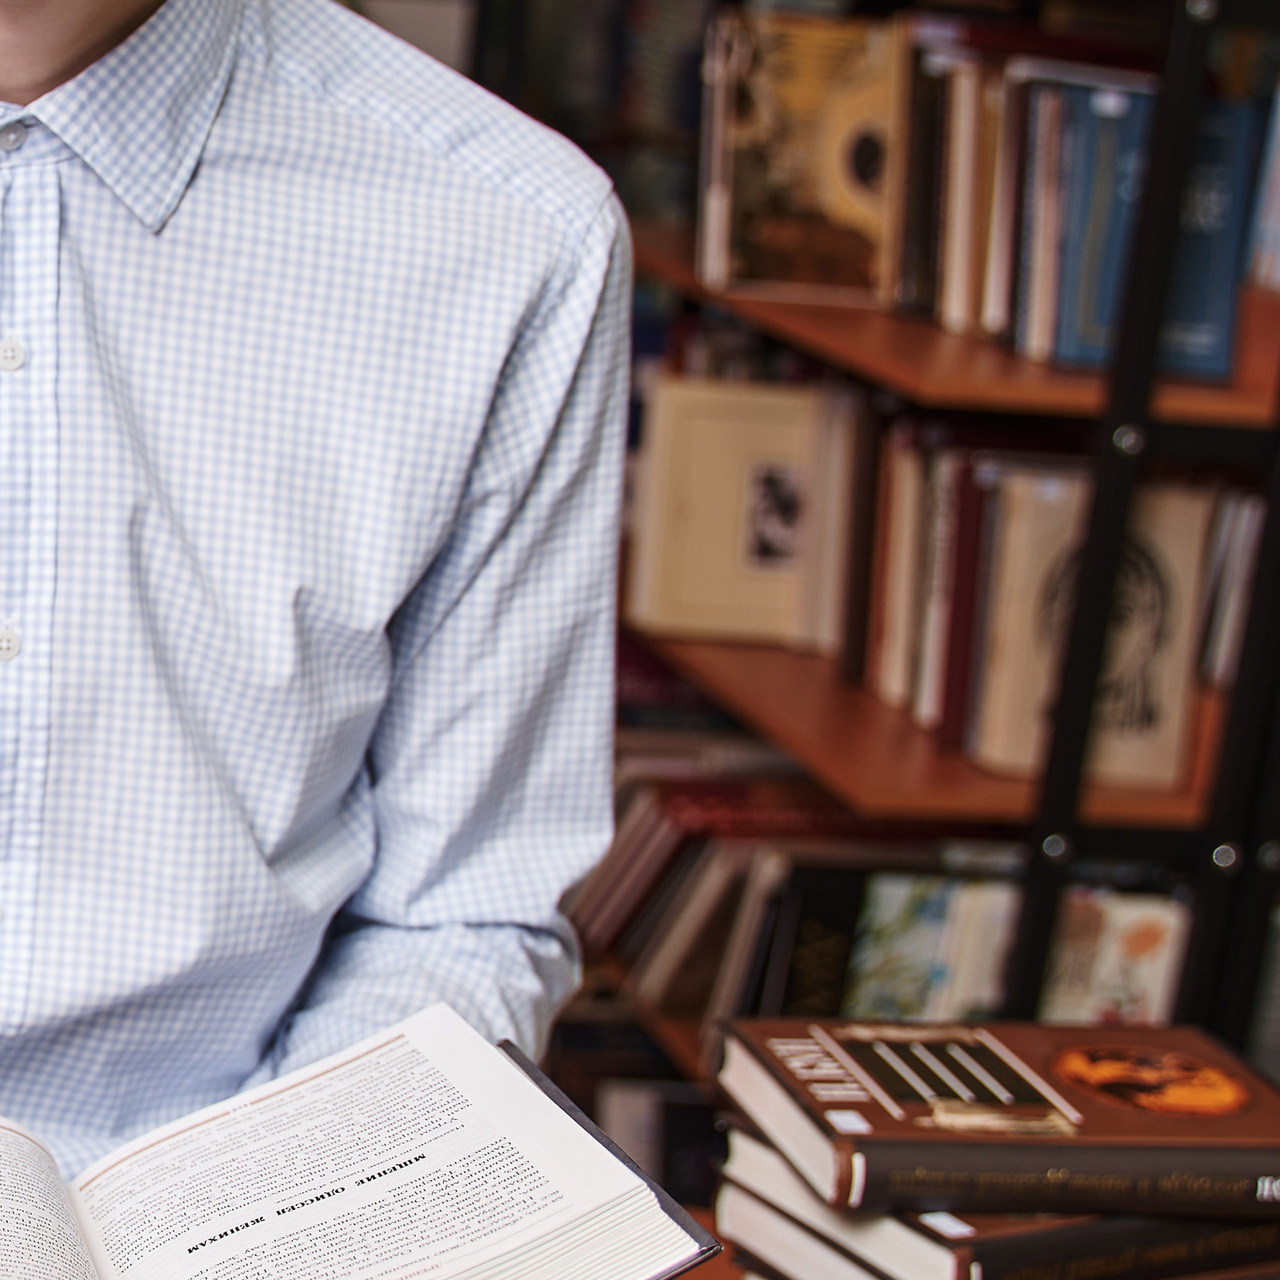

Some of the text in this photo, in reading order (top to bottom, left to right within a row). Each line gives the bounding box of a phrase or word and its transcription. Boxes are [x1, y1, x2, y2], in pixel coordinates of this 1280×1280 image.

[186, 1153, 426, 1254] МЩЕНИЕ ОДИССЕЯ ЖЕНИХАМ
